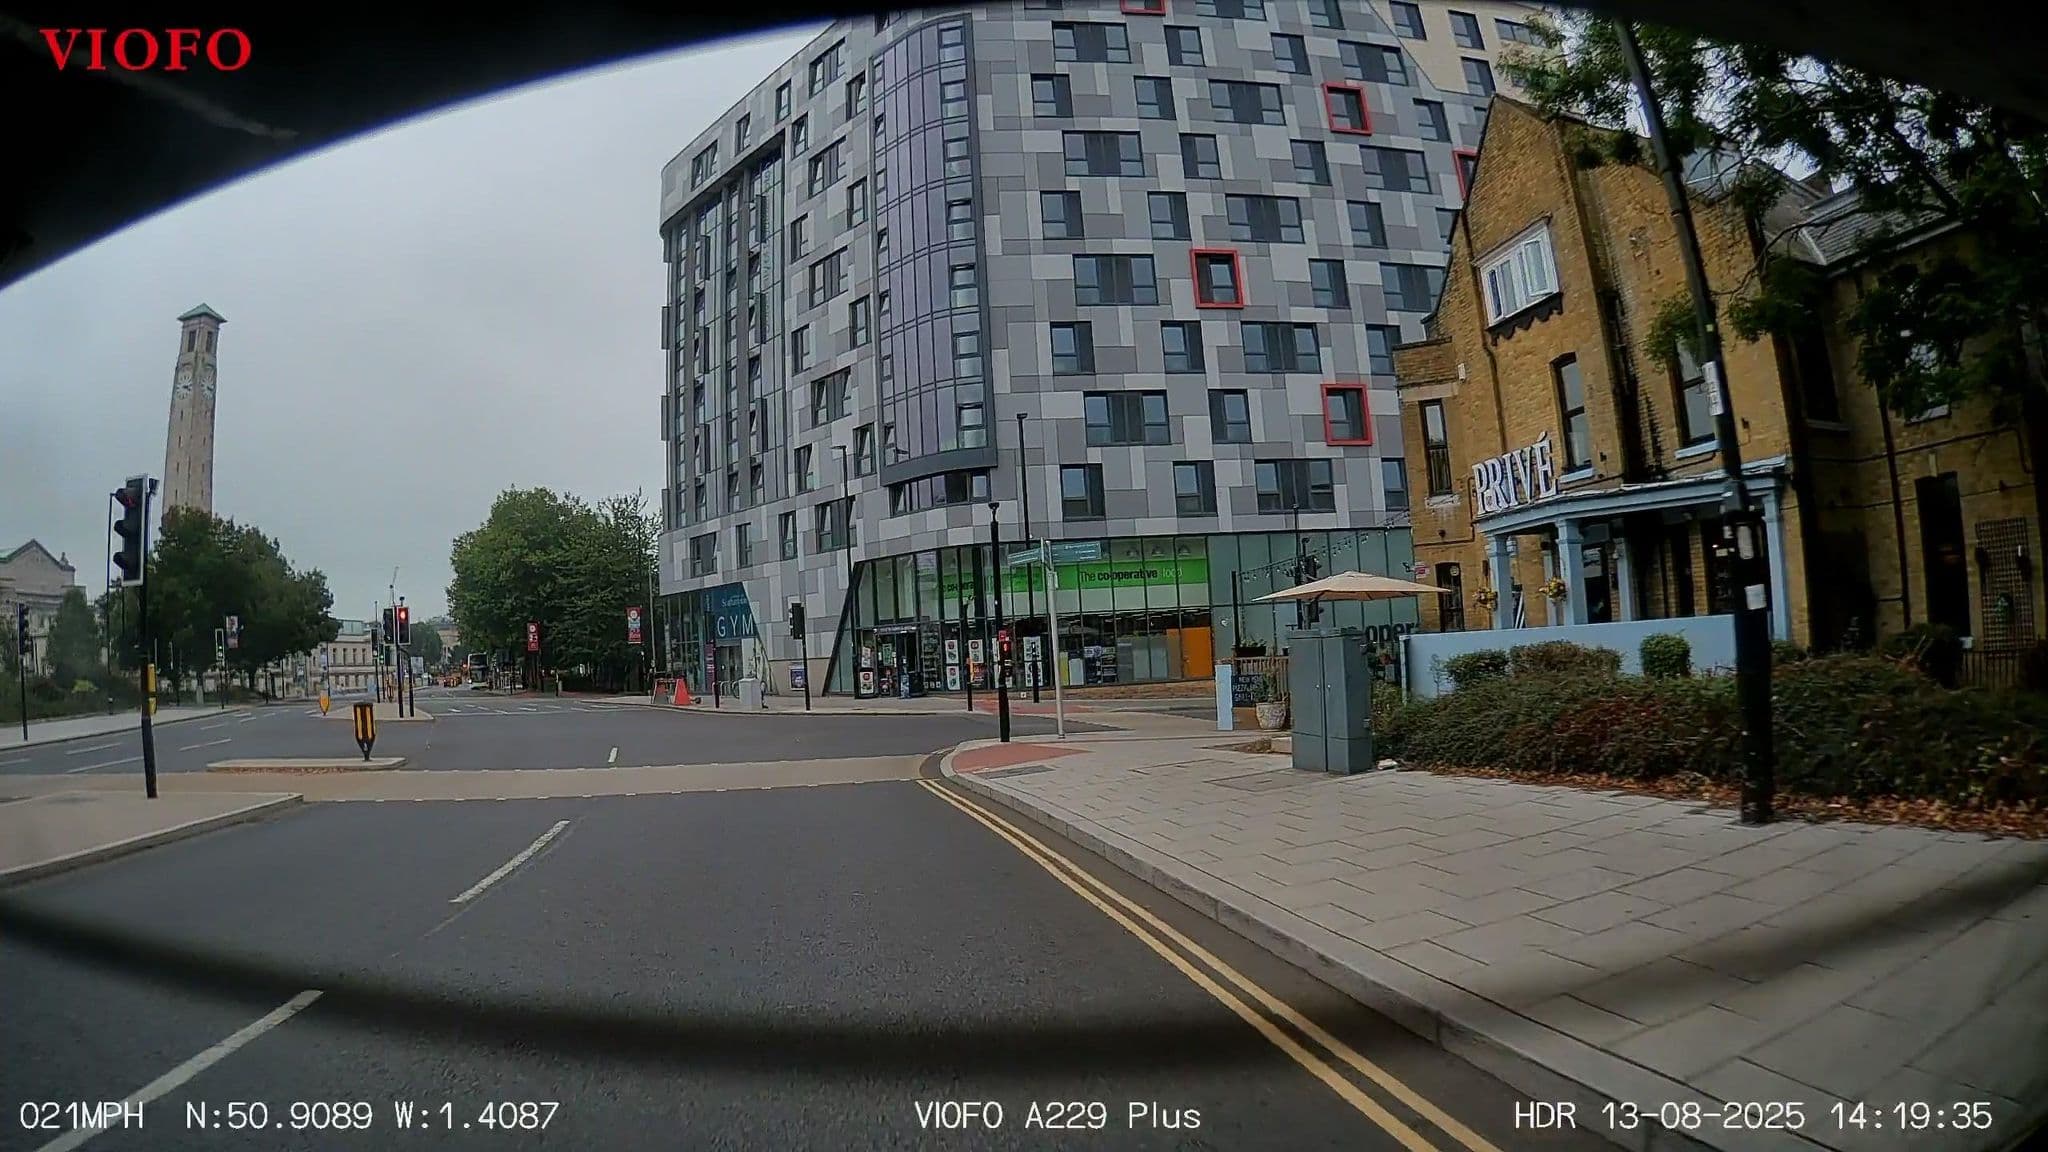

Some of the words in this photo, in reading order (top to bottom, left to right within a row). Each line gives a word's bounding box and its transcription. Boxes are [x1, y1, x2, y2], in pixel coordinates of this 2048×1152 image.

[1472, 431, 1558, 514] PRIVÉ
[1080, 571, 1096, 582] The
[717, 614, 754, 637] GYM
